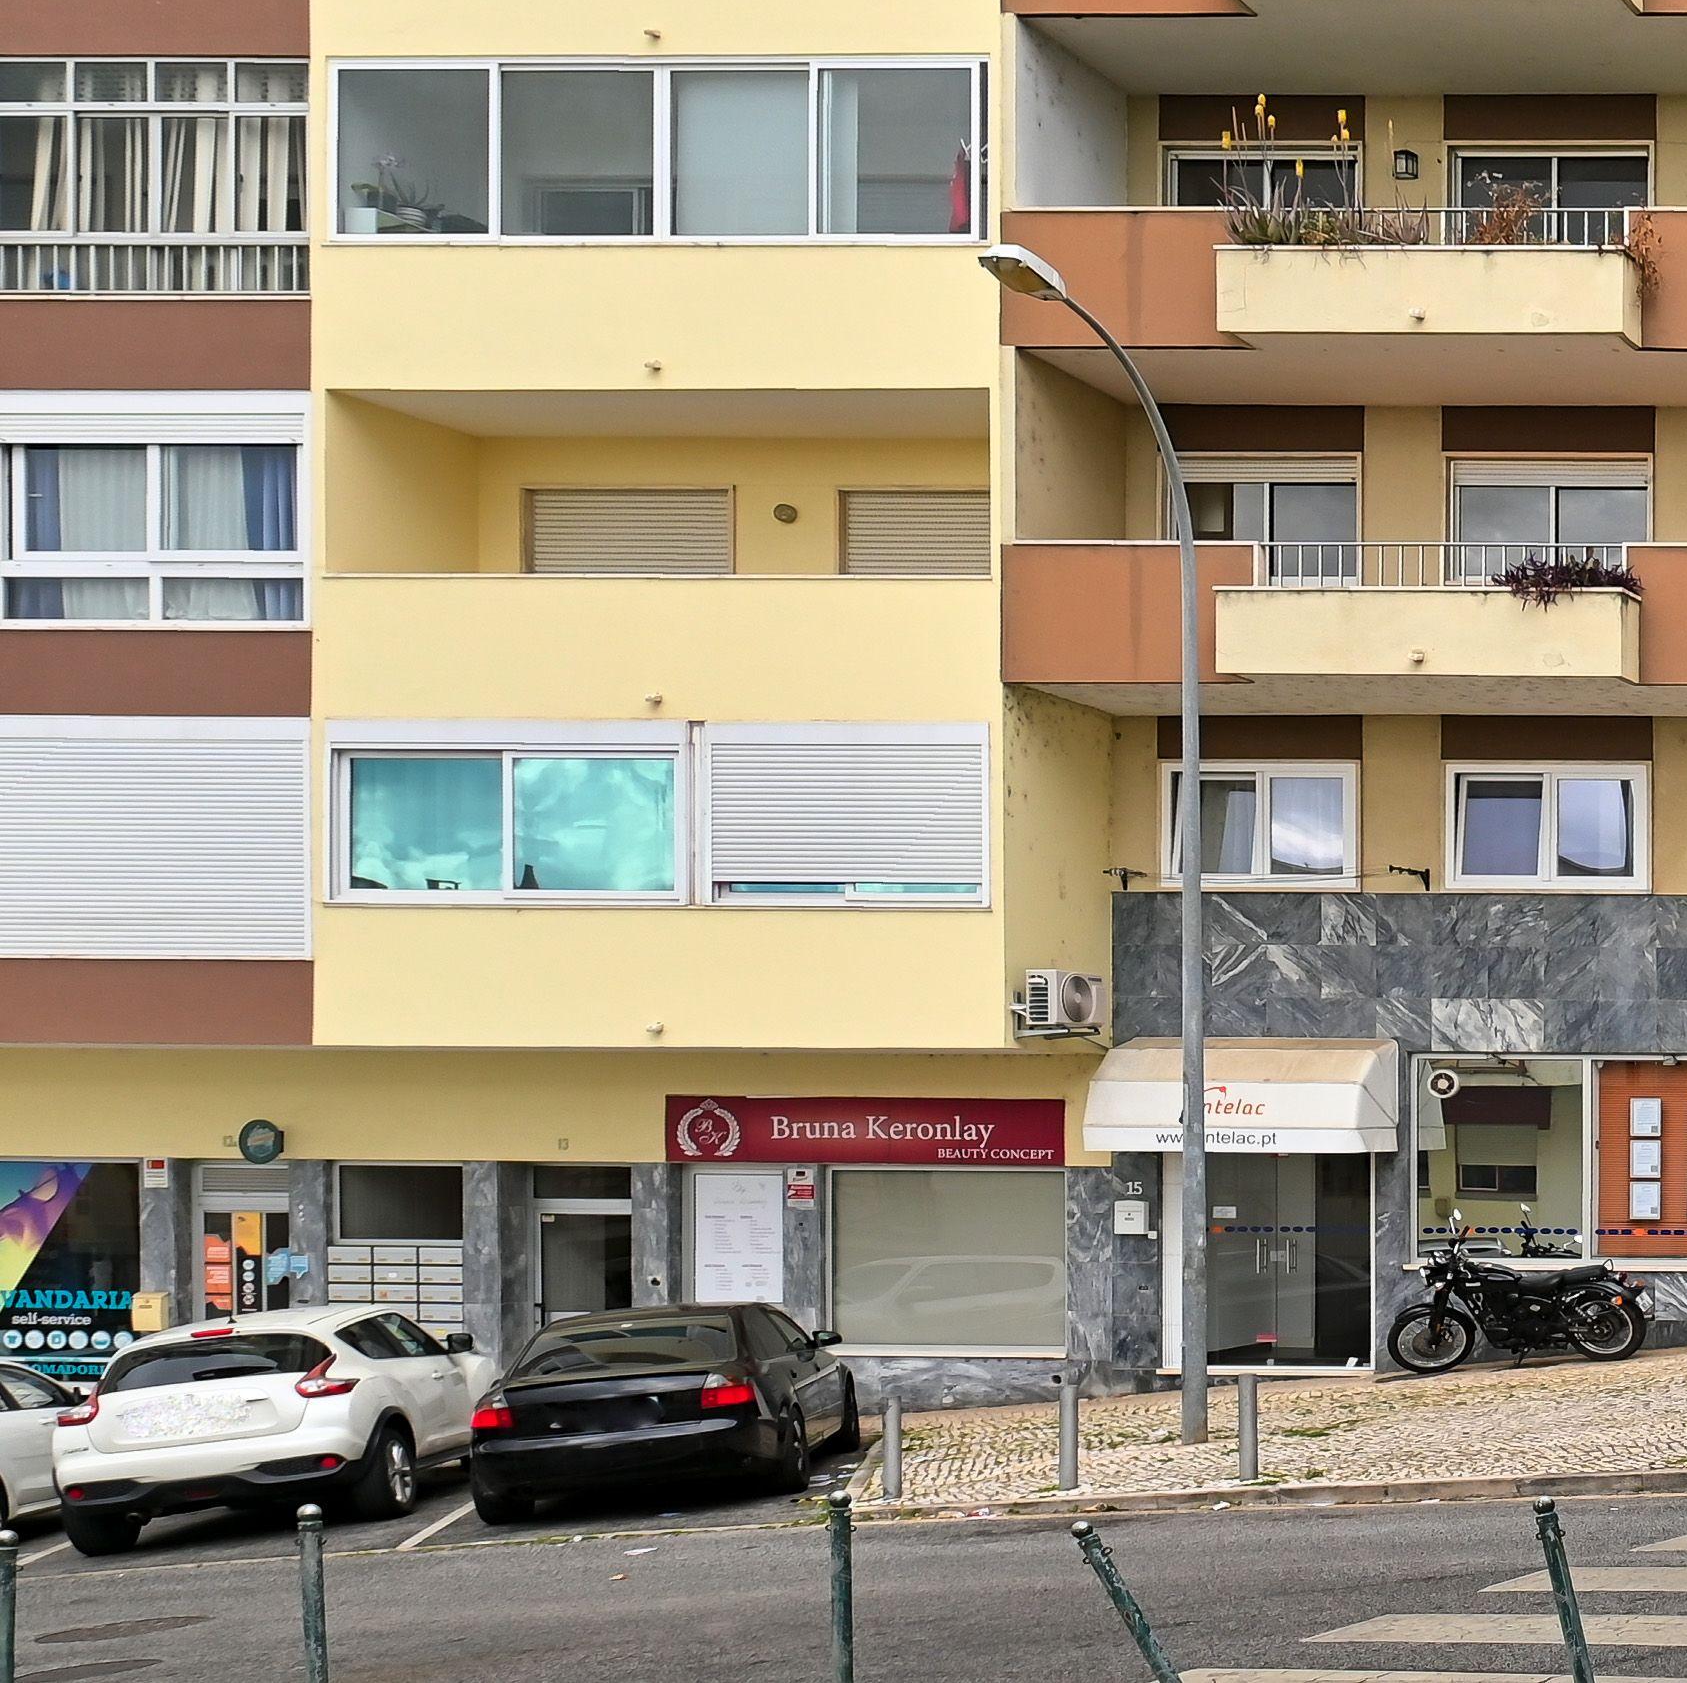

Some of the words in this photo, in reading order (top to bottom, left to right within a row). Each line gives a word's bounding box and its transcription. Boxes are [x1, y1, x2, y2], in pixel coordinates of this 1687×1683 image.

[1203, 1098, 1266, 1115] ntelac
[770, 1116, 856, 1140] Bruna
[866, 1115, 995, 1148] Keronlay
[558, 1138, 569, 1151] 13
[1155, 1131, 1277, 1148] wwntelac.pt
[937, 1148, 989, 1159] BEAUTY
[990, 1149, 1055, 1160] CONCEPT
[1126, 1181, 1143, 1195] 15
[12, 1312, 92, 1325] self-service
[30, 1364, 105, 1375] OMADORI
